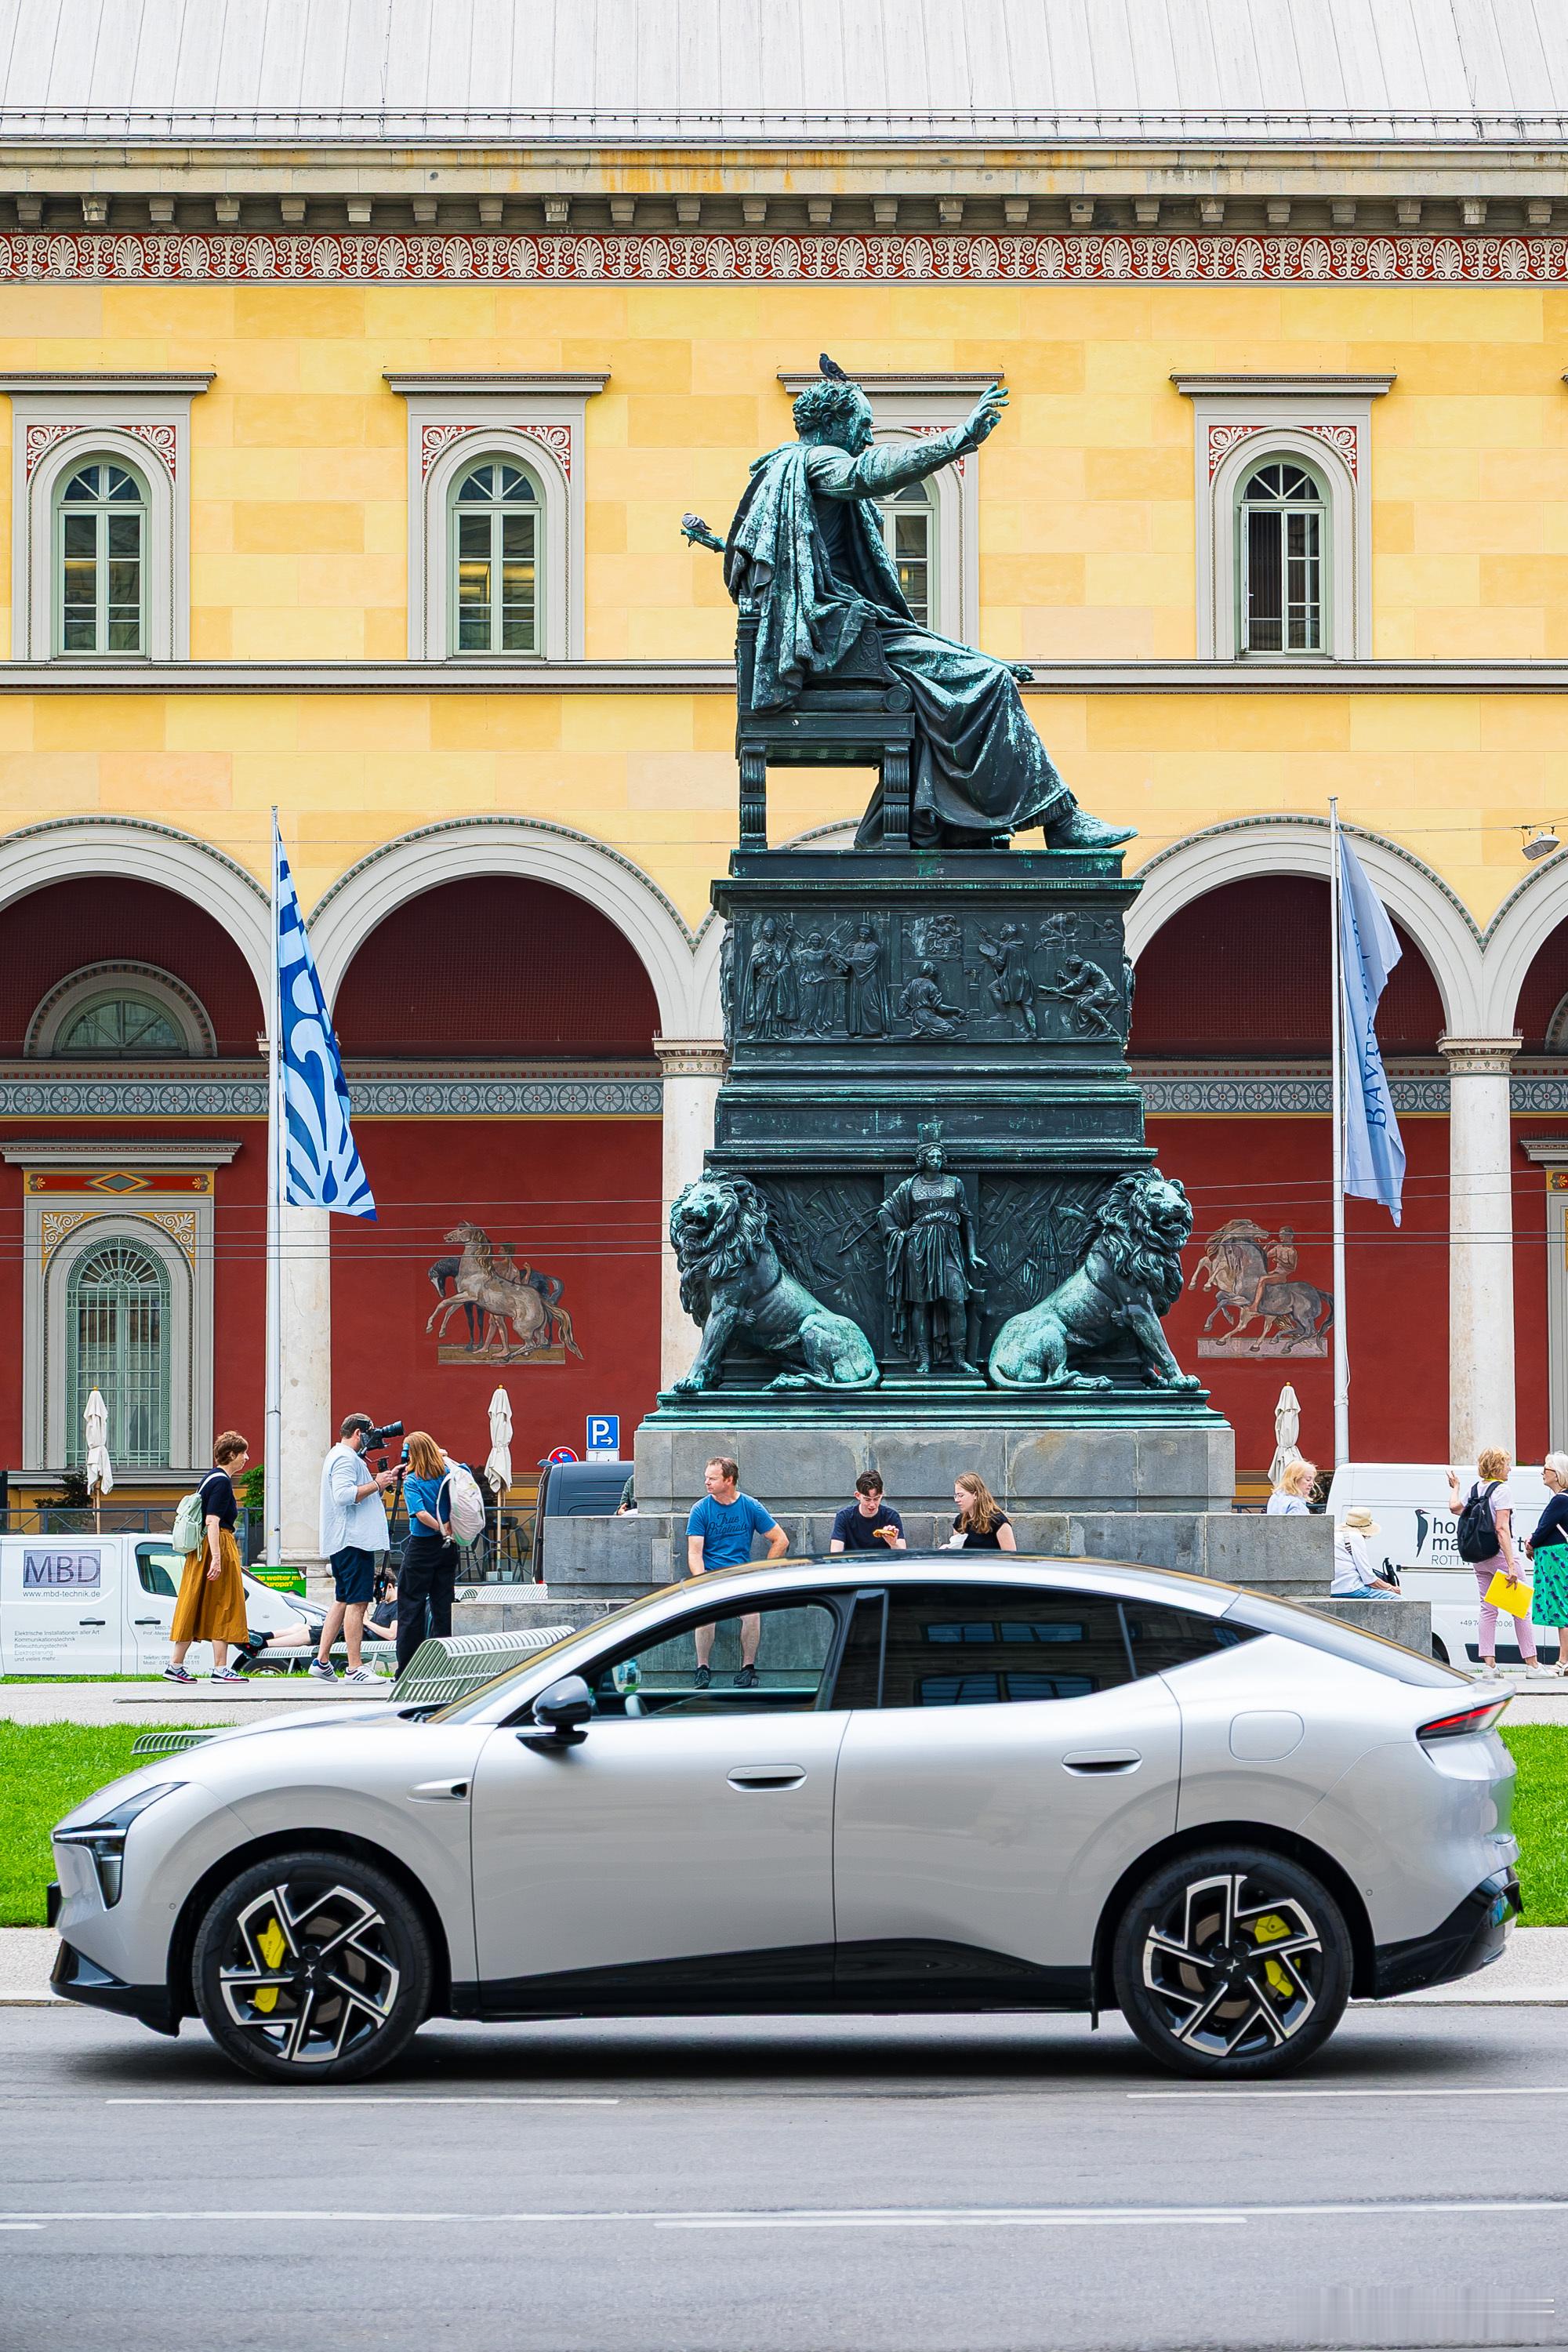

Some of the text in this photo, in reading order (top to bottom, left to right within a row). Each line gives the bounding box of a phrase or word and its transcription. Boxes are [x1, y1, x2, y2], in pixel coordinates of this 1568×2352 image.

[592, 1419, 610, 1446] P
[707, 1521, 748, 1537] Originals
[717, 1512, 740, 1527] True
[24, 1555, 100, 1583] MBD
